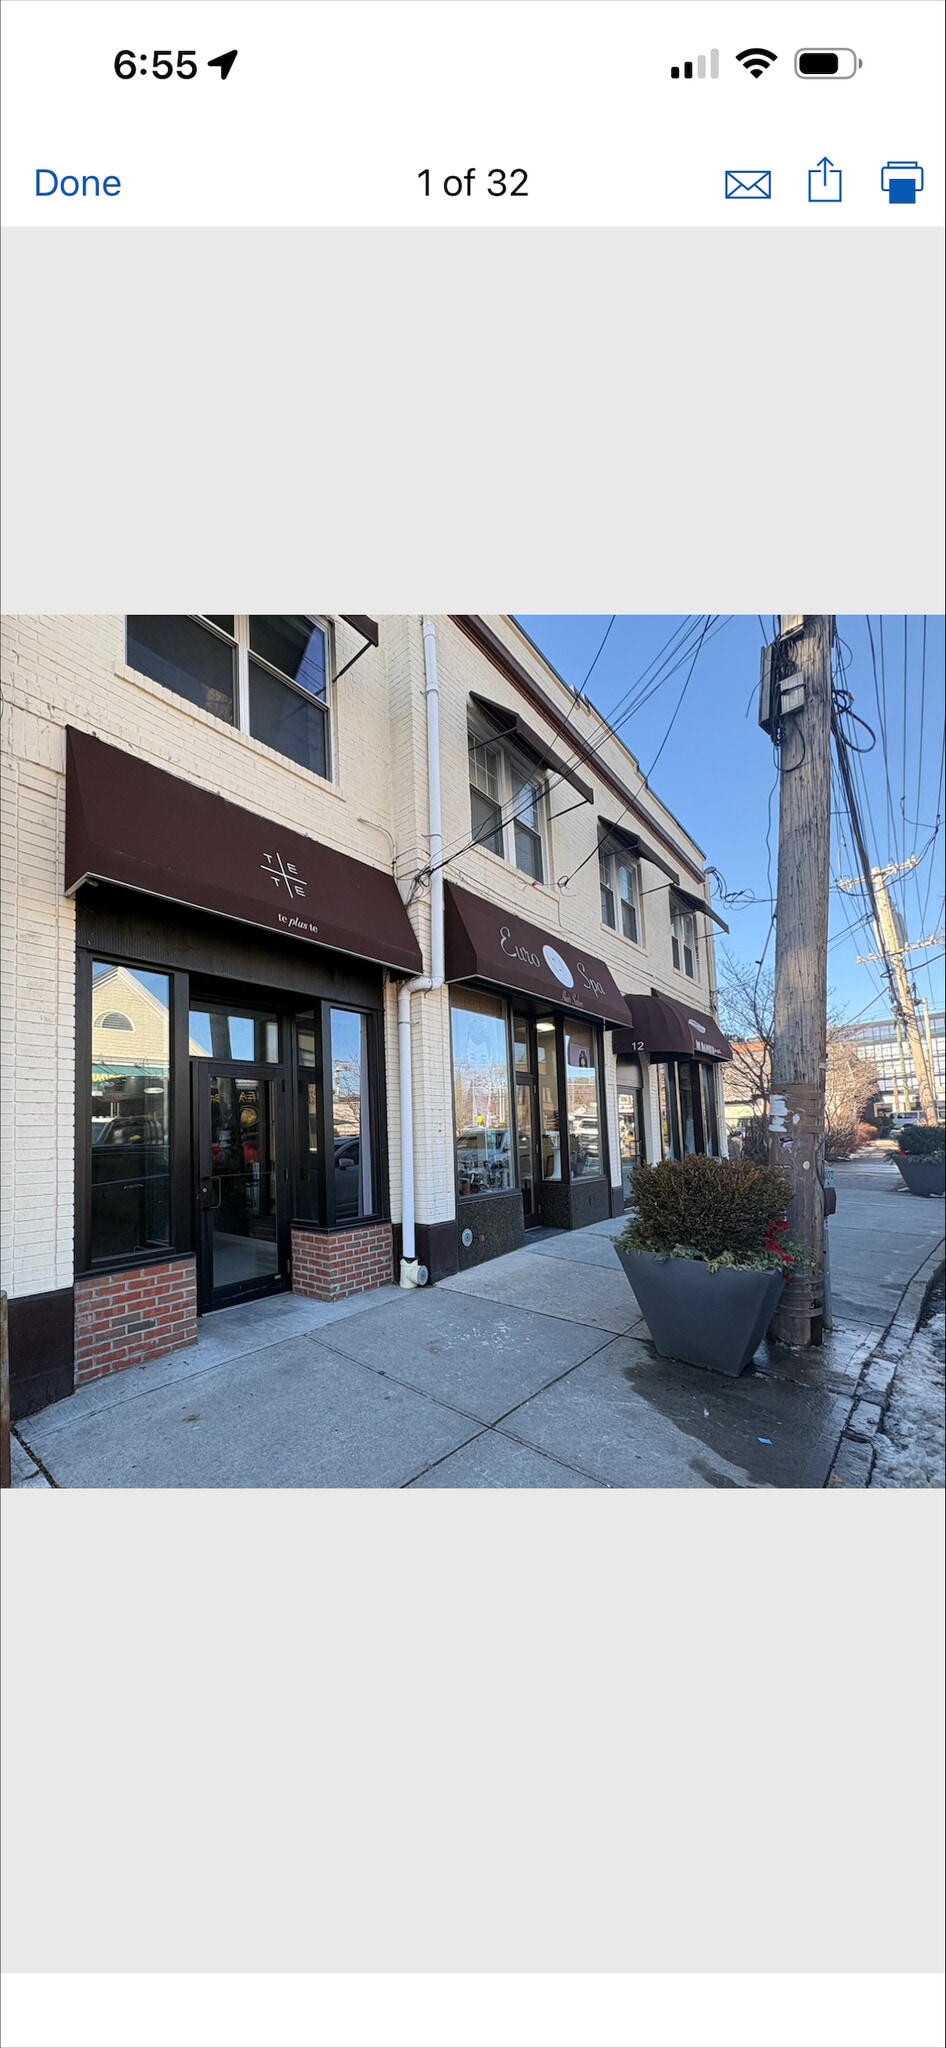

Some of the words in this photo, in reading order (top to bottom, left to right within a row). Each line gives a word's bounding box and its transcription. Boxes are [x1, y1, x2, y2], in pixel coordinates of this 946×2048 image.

[278, 913, 288, 924] te
[288, 917, 308, 931] plus
[309, 923, 319, 933] te
[499, 926, 541, 968] Euro
[576, 962, 606, 998] Spa
[631, 1041, 645, 1051] 12
